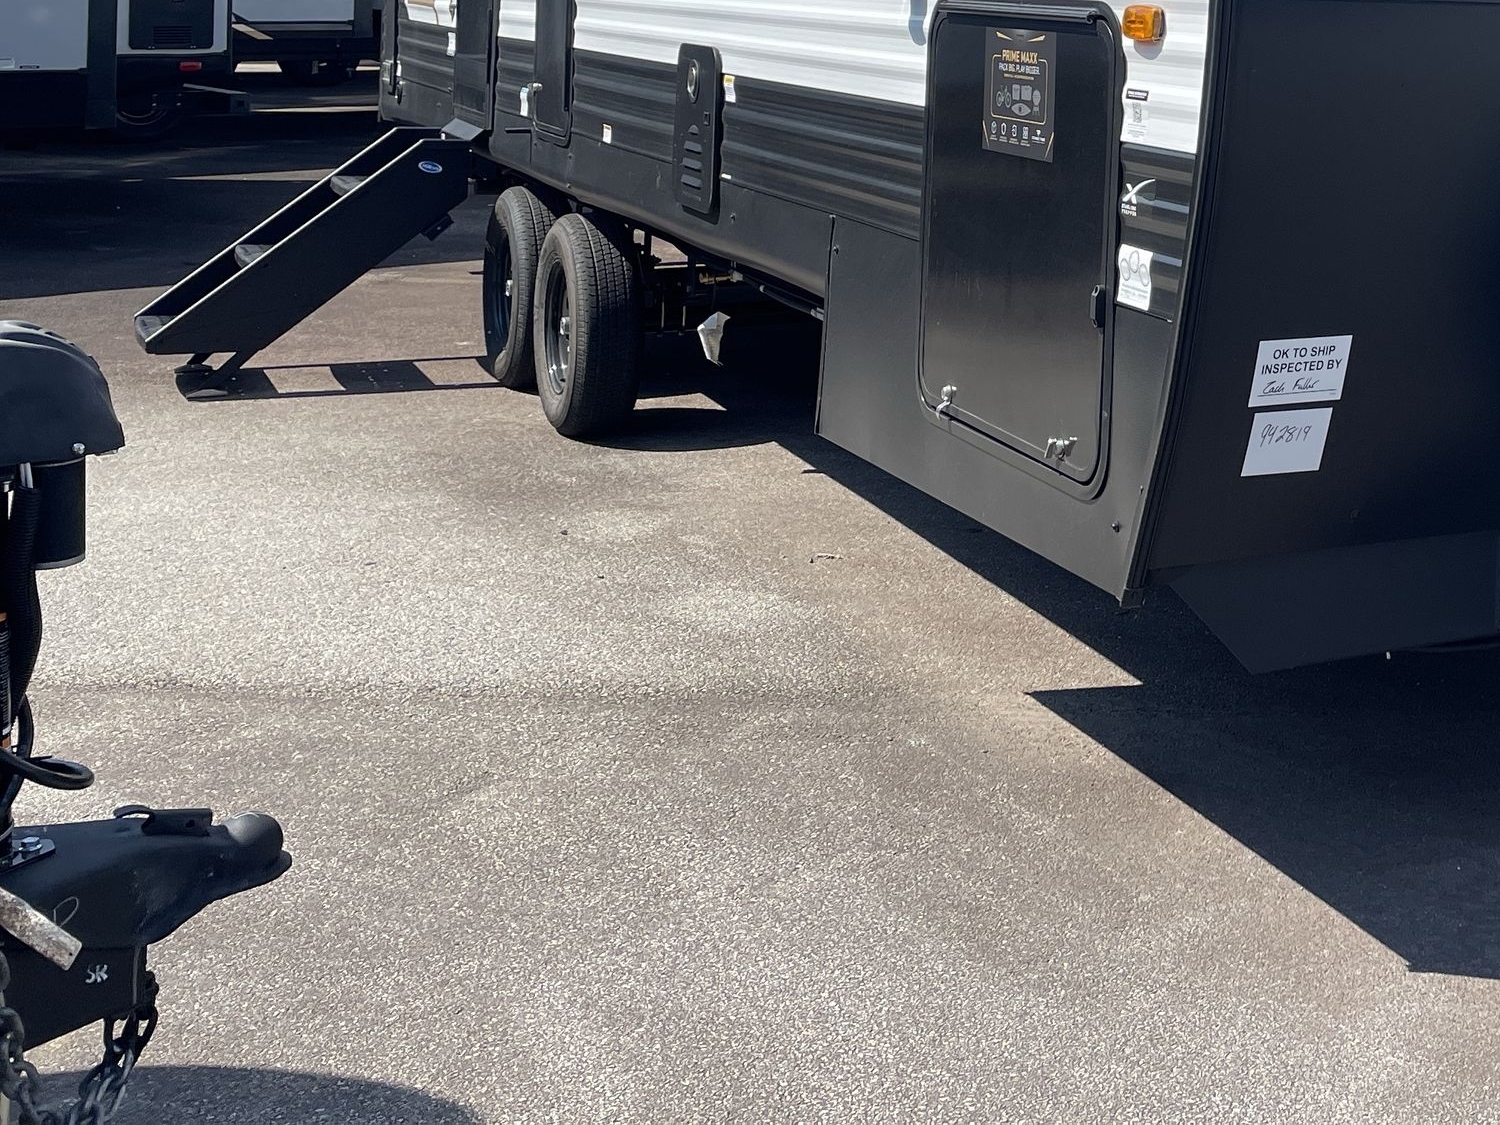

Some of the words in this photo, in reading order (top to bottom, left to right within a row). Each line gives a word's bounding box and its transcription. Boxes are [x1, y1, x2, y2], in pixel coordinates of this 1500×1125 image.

[1002, 49, 1020, 63] PRIME
[1021, 51, 1038, 65] MAXX
[1273, 348, 1290, 360] OK
[1293, 347, 1307, 358] TO
[1310, 345, 1336, 357] SHIP
[1261, 360, 1324, 375] INSPECTED
[1327, 358, 1342, 370] BY
[1260, 424, 1312, 448] 942819
